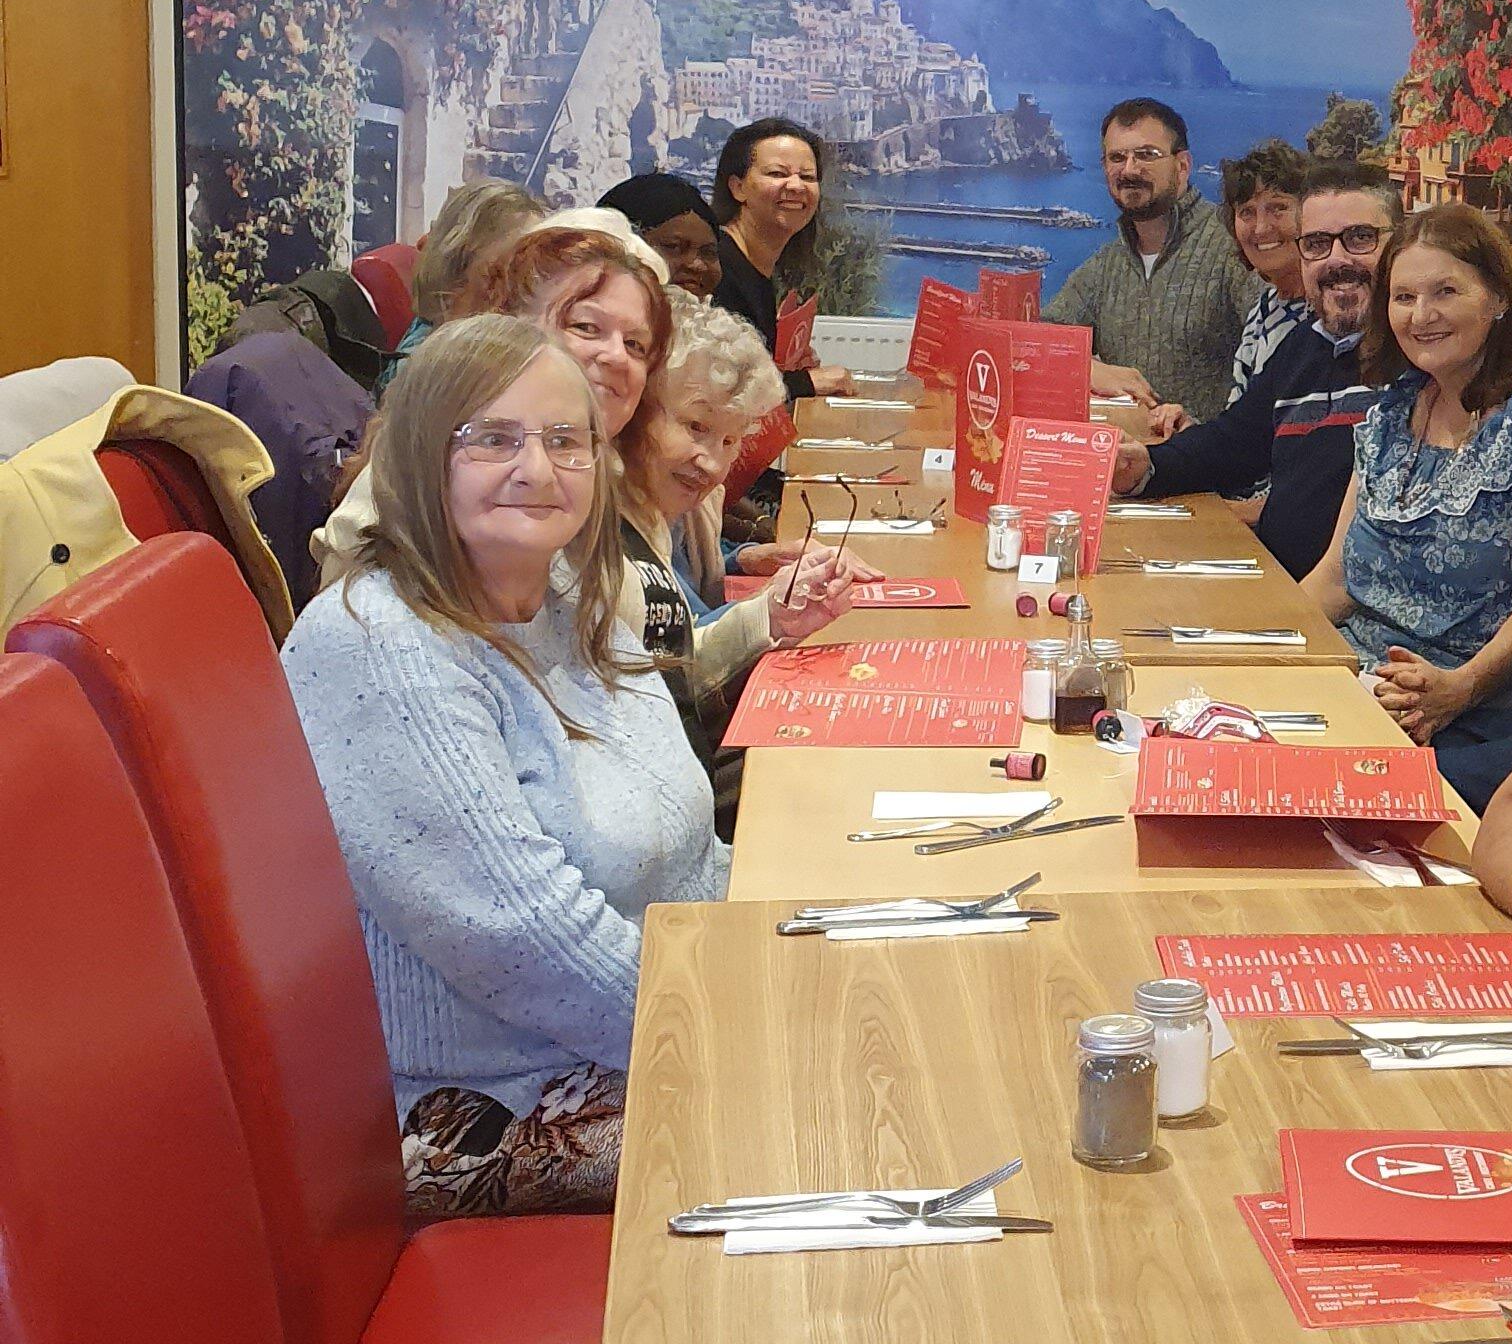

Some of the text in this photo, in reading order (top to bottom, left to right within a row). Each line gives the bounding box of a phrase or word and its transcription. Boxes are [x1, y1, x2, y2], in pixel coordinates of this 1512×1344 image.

[934, 454, 943, 464] 4
[1034, 562, 1044, 575] 7
[1376, 1155, 1444, 1180] V
